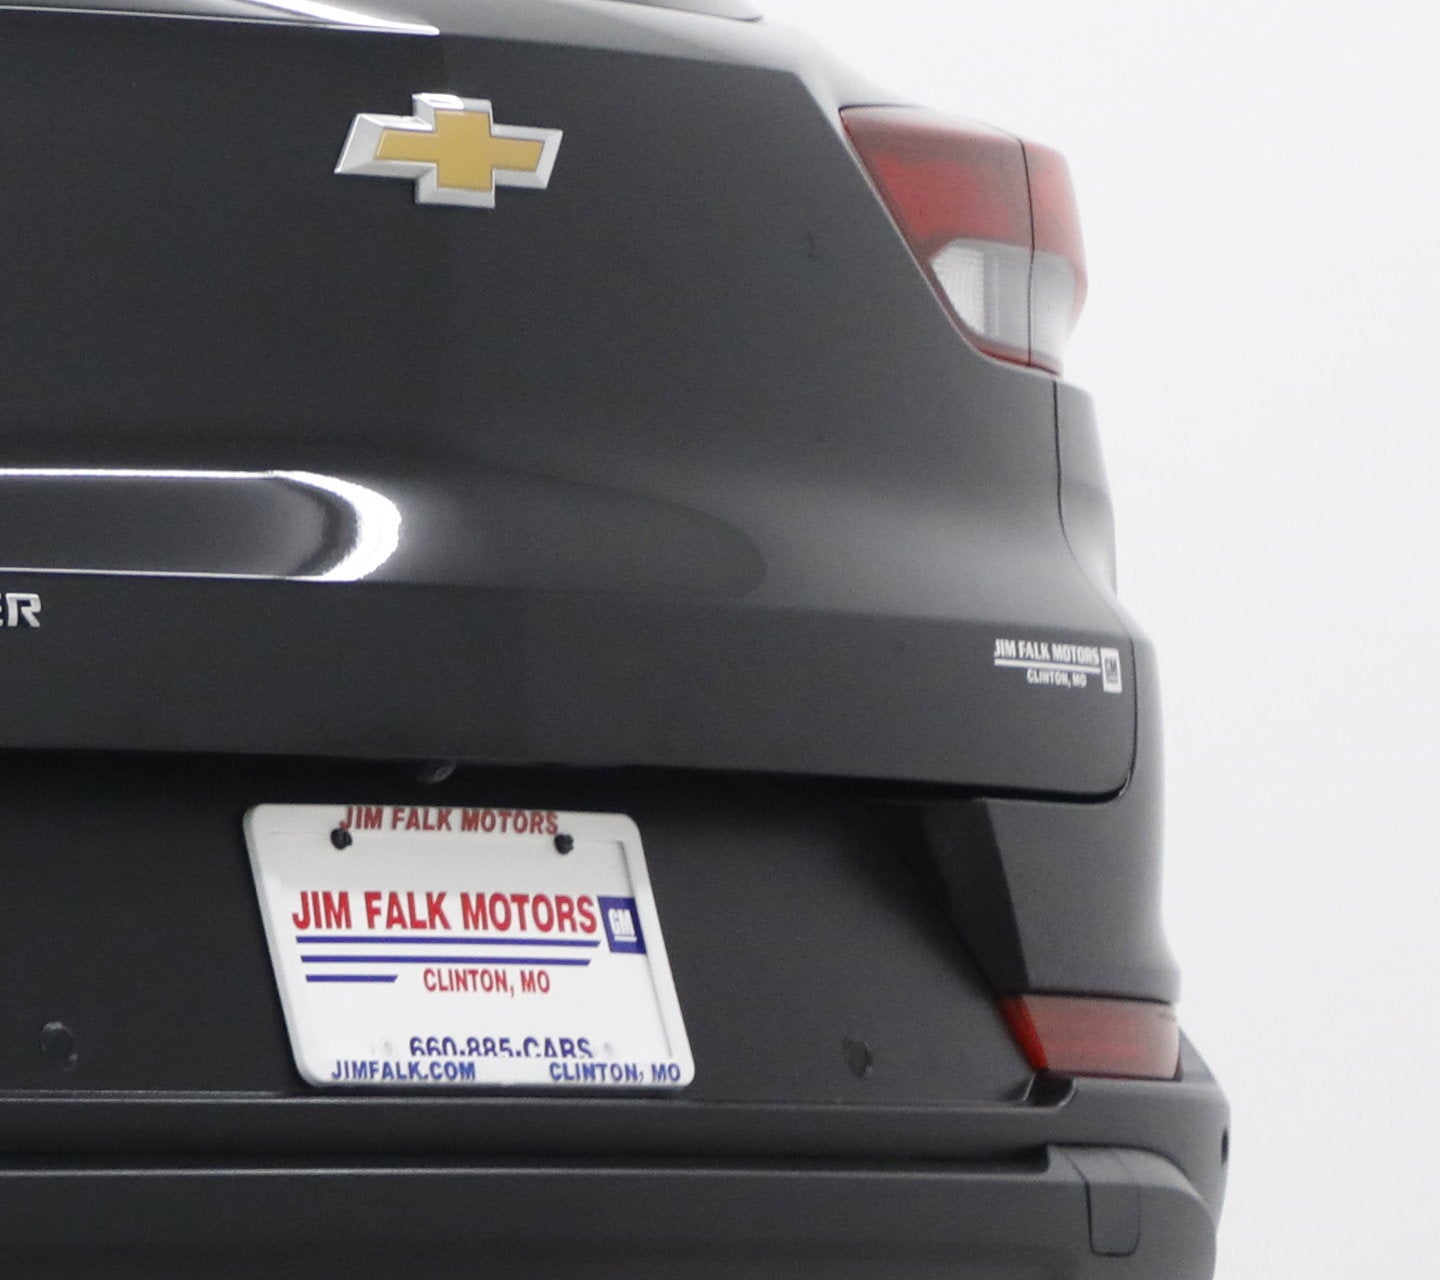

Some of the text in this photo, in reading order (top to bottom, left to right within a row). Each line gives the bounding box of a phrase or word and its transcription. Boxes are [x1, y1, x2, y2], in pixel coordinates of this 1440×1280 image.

[993, 638, 1100, 665] JIM FALK MOTORS
[1026, 668, 1087, 688] CLINTON, MO
[339, 806, 559, 835] JIM FALK MOTORS
[292, 891, 598, 934] JIM FALK MOTORS
[423, 968, 551, 998] CLINTON, MO
[331, 1060, 477, 1081] JIMFALK.COM
[549, 1062, 681, 1082] CLINTON, MO
